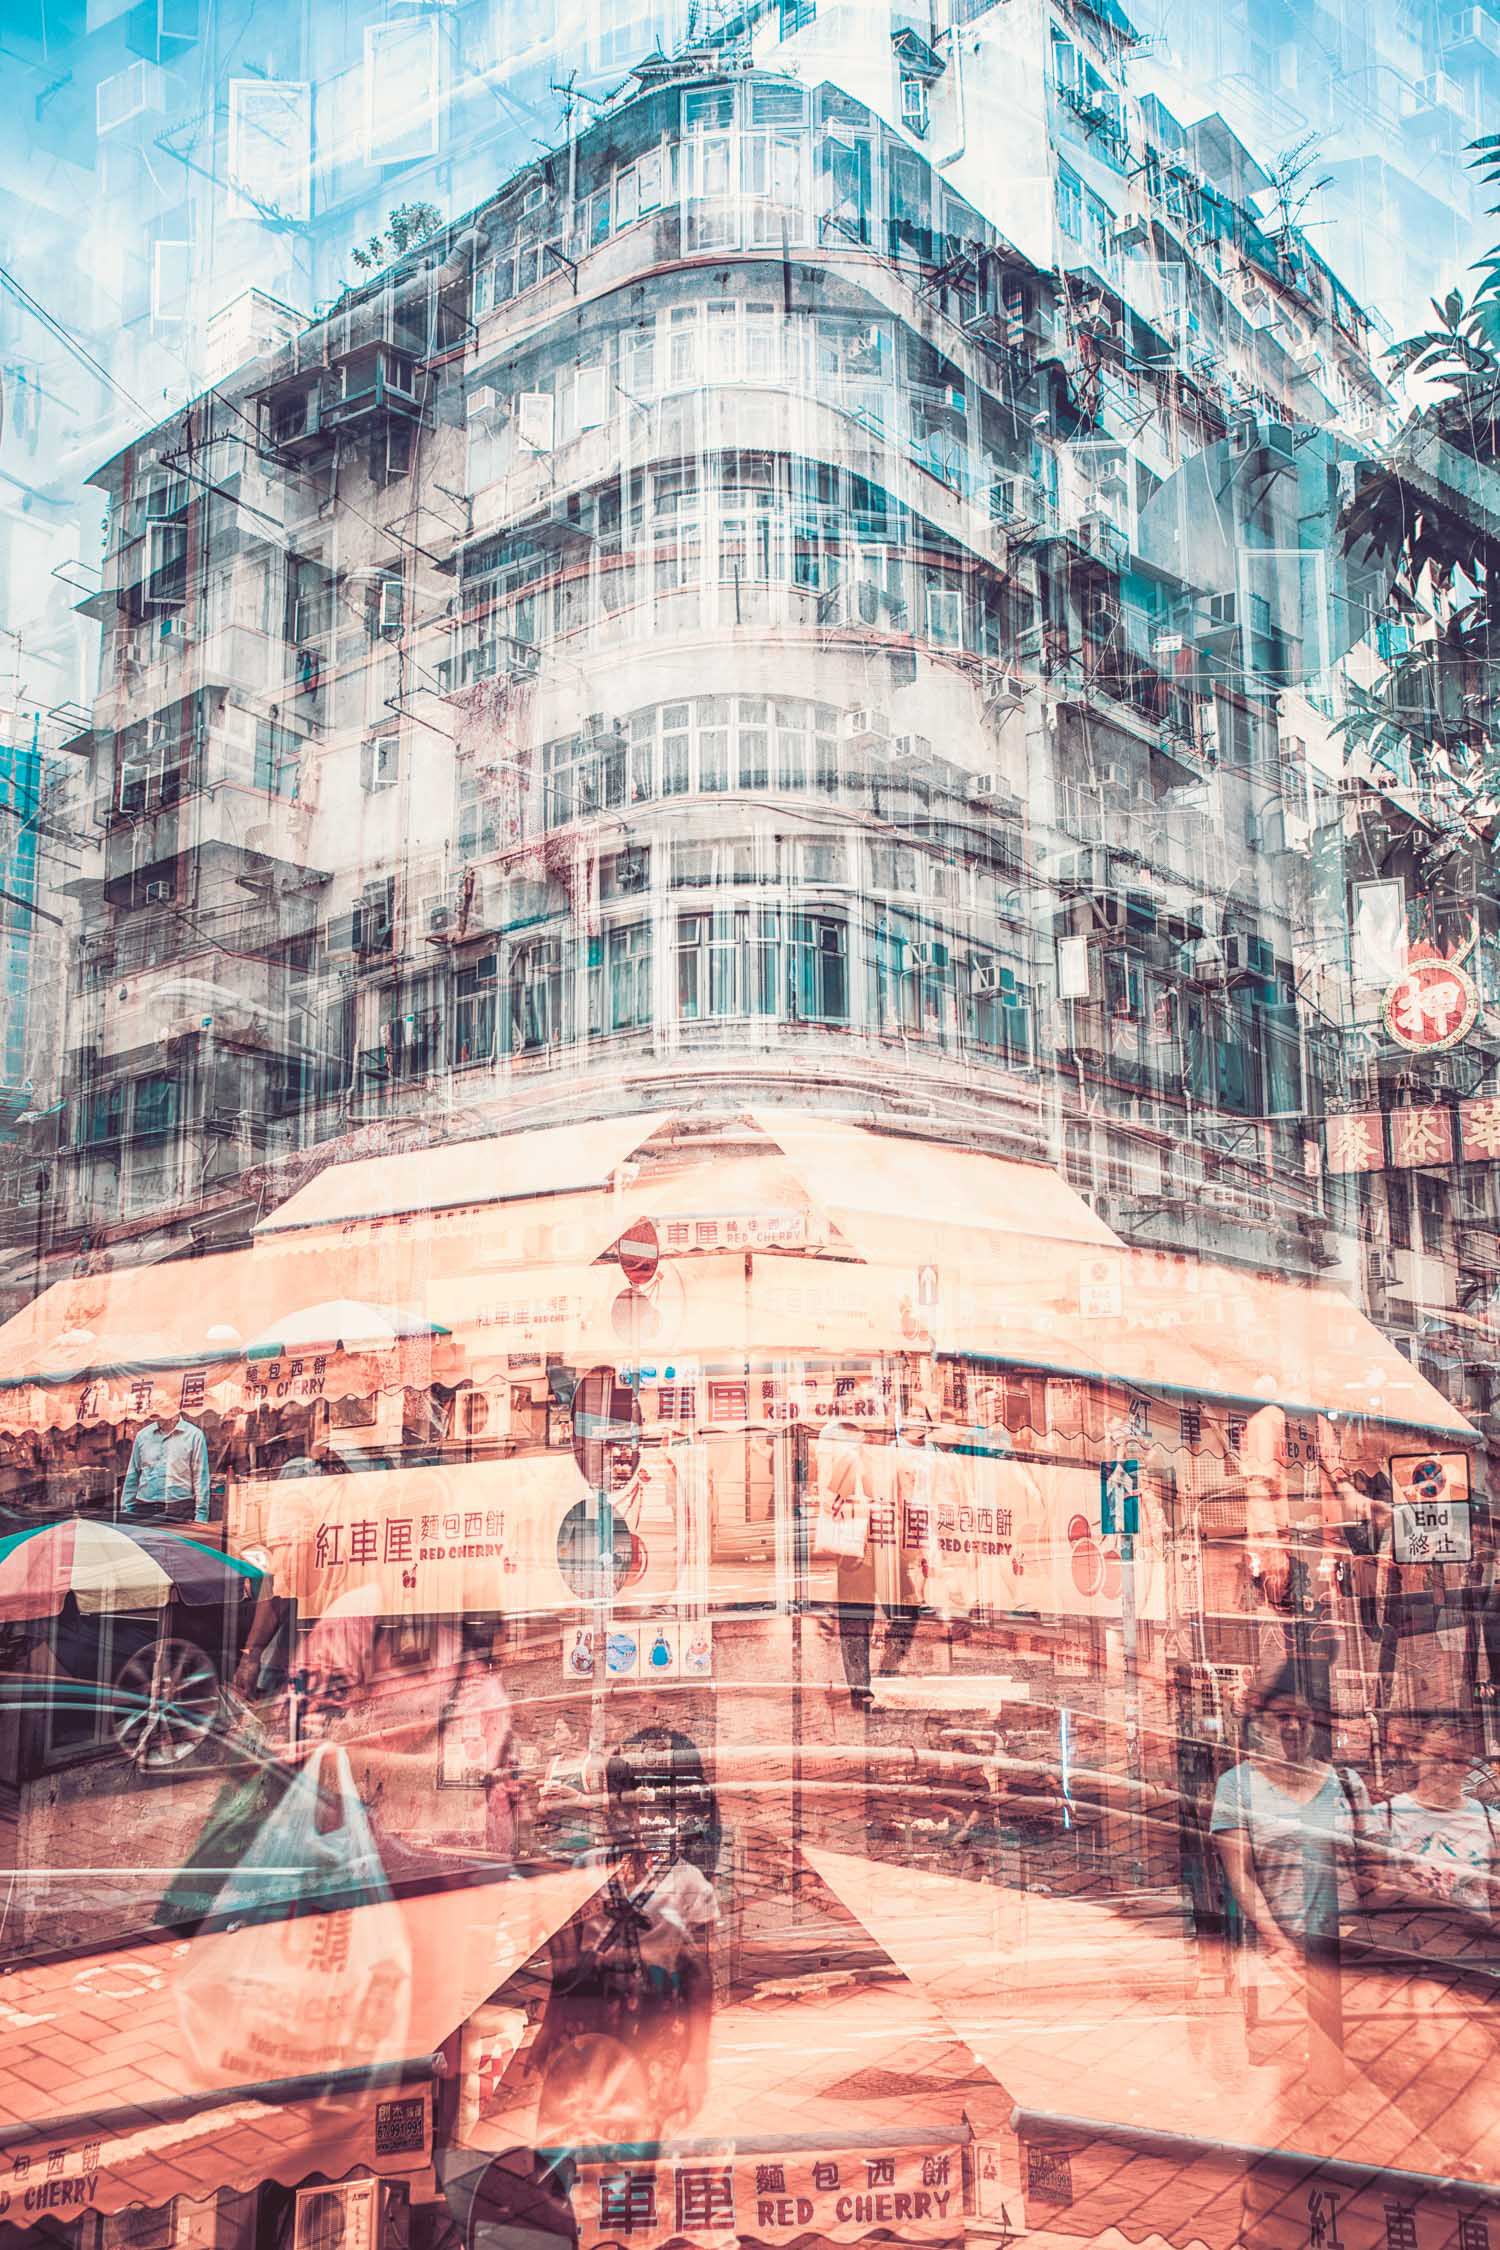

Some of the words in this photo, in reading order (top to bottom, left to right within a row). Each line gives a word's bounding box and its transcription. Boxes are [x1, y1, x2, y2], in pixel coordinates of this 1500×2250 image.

[1396, 975, 1459, 1036] 押
[656, 1221, 719, 1246] 車厘
[276, 1376, 326, 1398] CHERRY
[763, 1402, 799, 1420] RED
[420, 1510, 505, 1541] 麵包西餅
[1415, 1510, 1449, 1526] End
[315, 1517, 414, 1569] 紅車厘
[419, 1547, 446, 1561] RED
[449, 1544, 504, 1558] CHERRY
[1409, 1533, 1457, 1556] 終止
[755, 2156, 951, 2195] 麵包西餅
[24, 2175, 98, 2212] CHERRY
[757, 2199, 815, 2227] RED
[836, 2190, 951, 2223] CHERRY
[1306, 2189, 1489, 2250] 紅車厘
